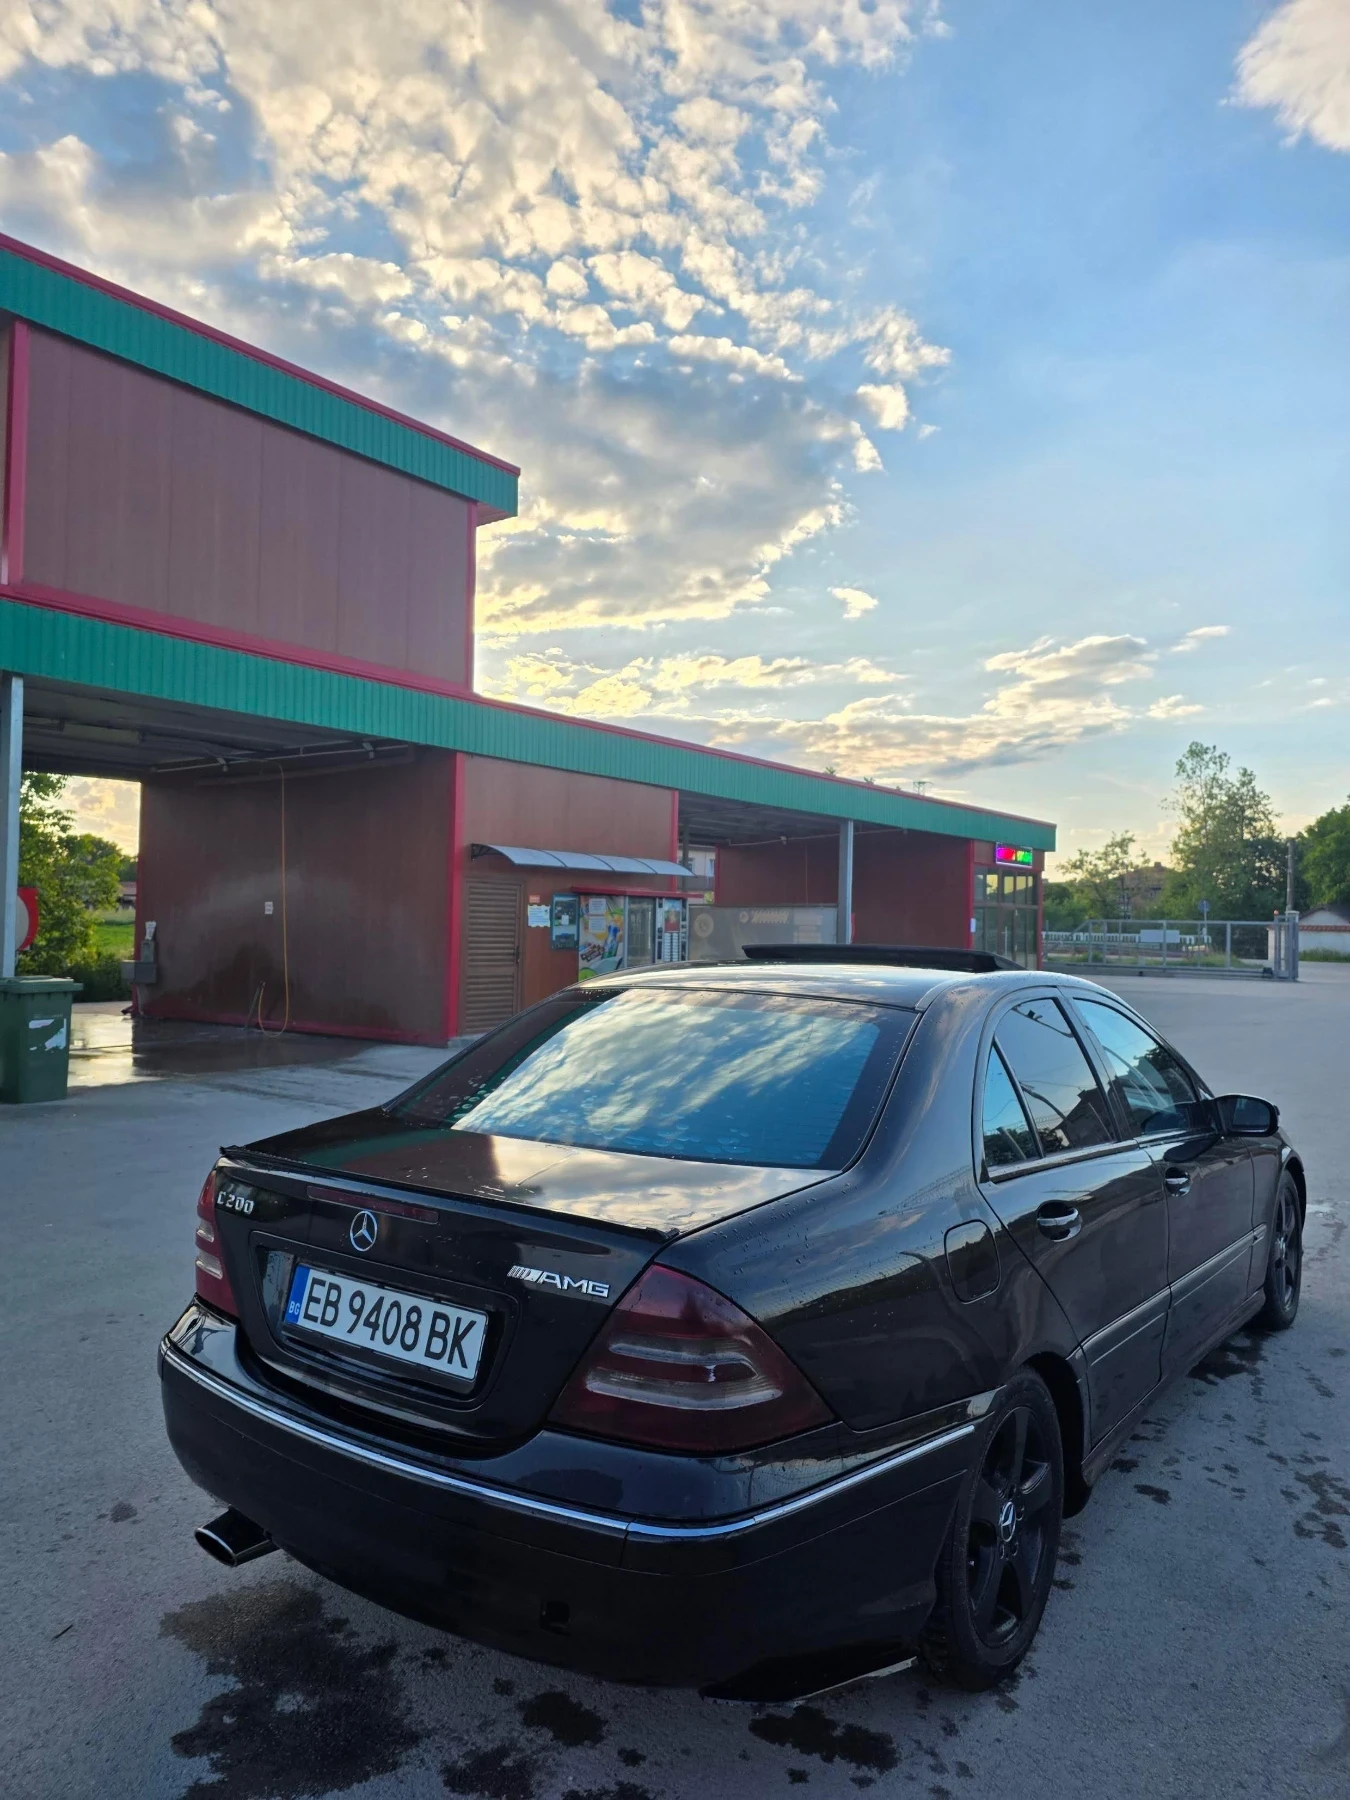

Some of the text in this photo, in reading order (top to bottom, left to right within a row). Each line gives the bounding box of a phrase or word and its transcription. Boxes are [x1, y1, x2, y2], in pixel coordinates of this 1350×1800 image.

[537, 1271, 610, 1298] AMG
[288, 1300, 300, 1316] BG
[303, 1277, 477, 1369] EB 9408 BK
